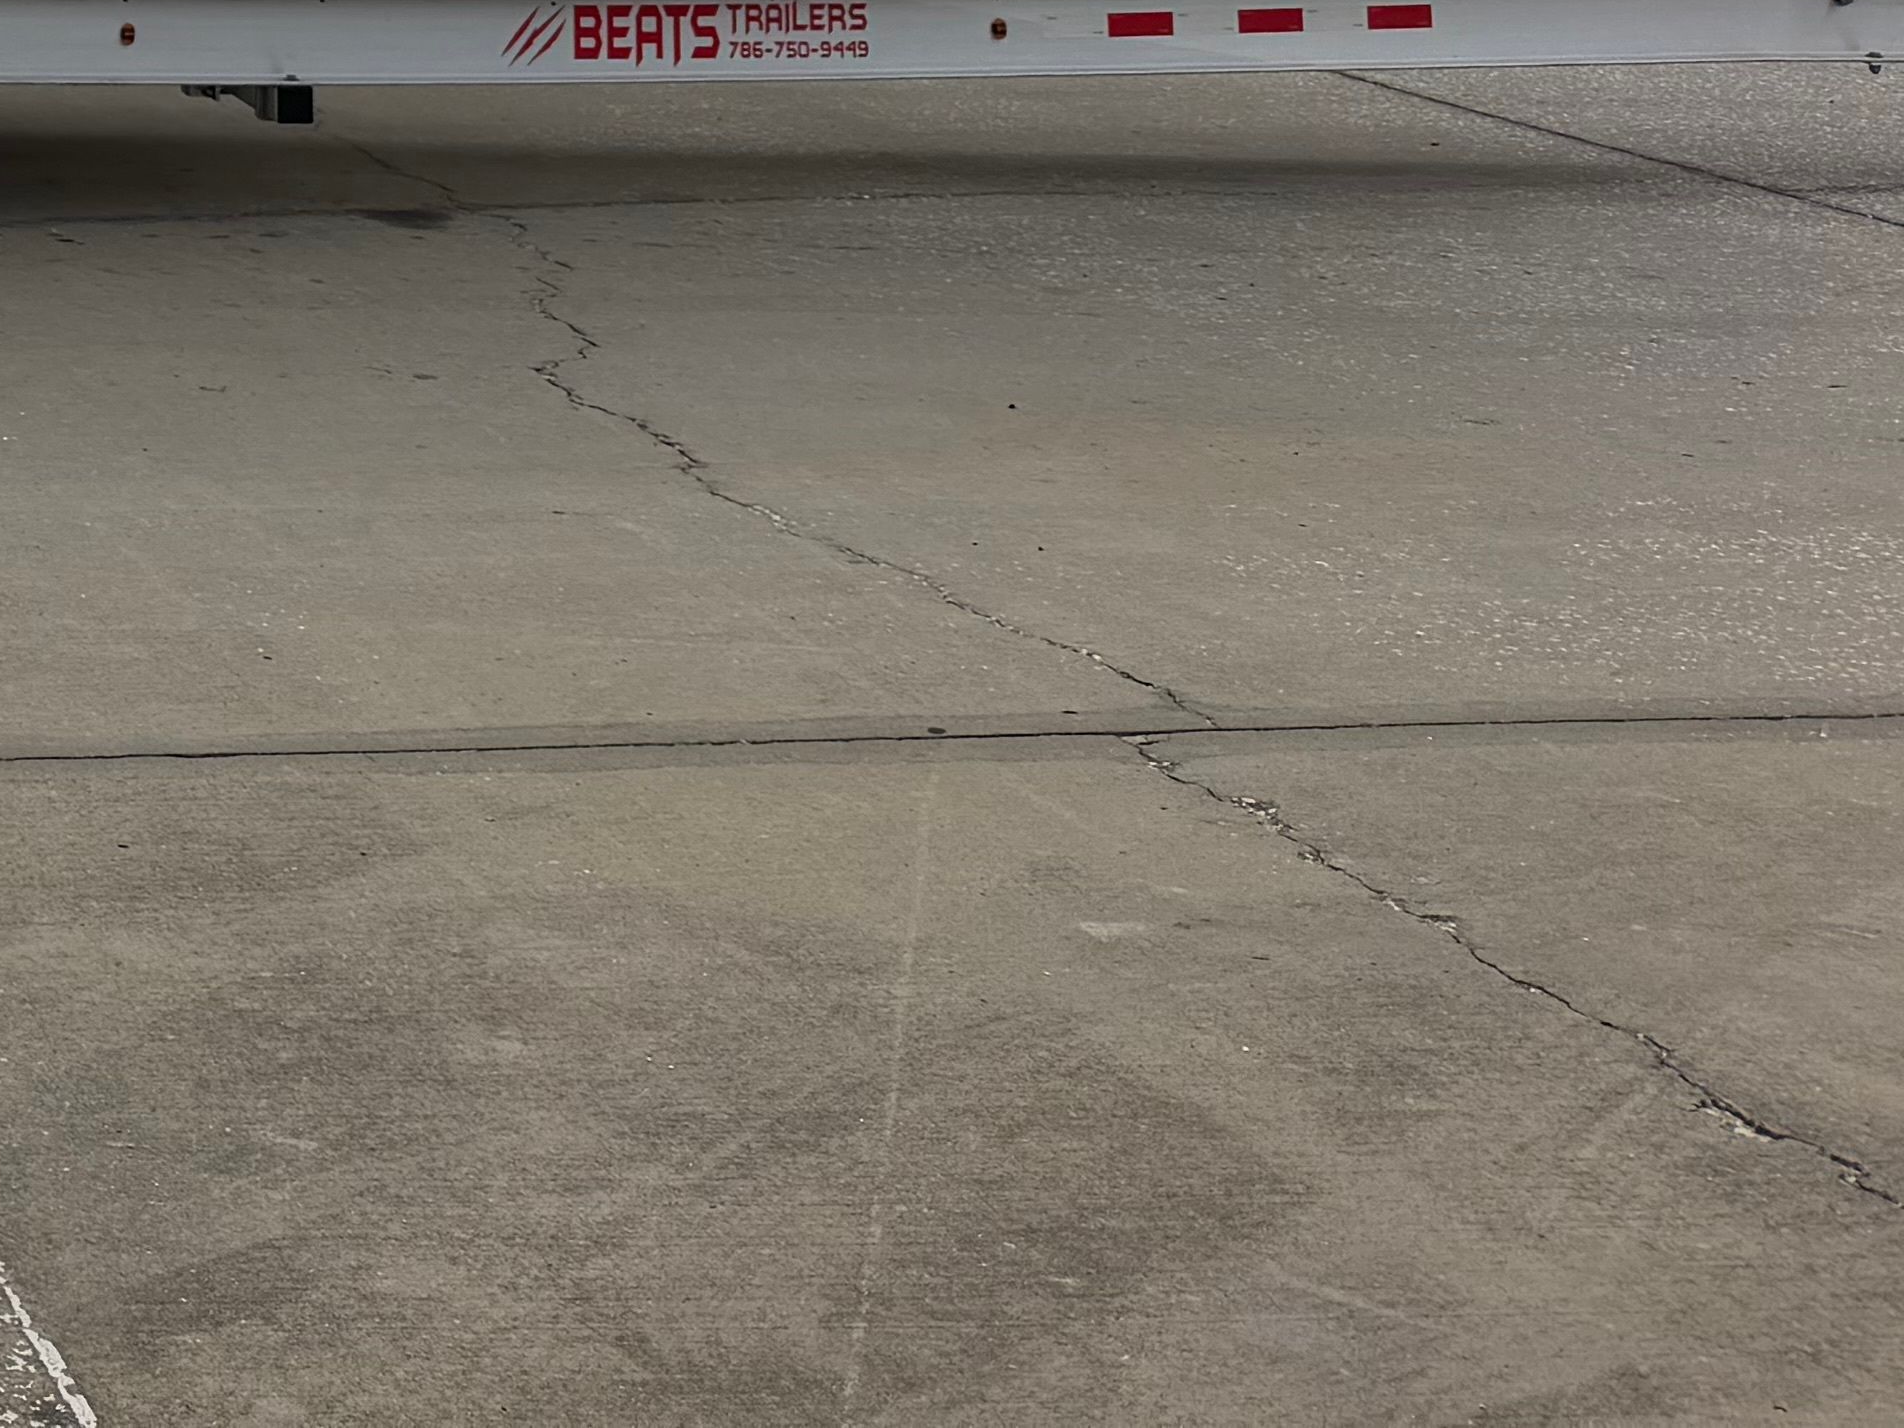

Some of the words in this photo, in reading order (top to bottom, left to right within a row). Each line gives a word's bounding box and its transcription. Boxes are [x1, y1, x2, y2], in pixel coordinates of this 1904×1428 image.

[573, 3, 721, 68] BEATS
[725, 0, 868, 35] TRAILERS
[728, 40, 870, 59] 786-750-9449
